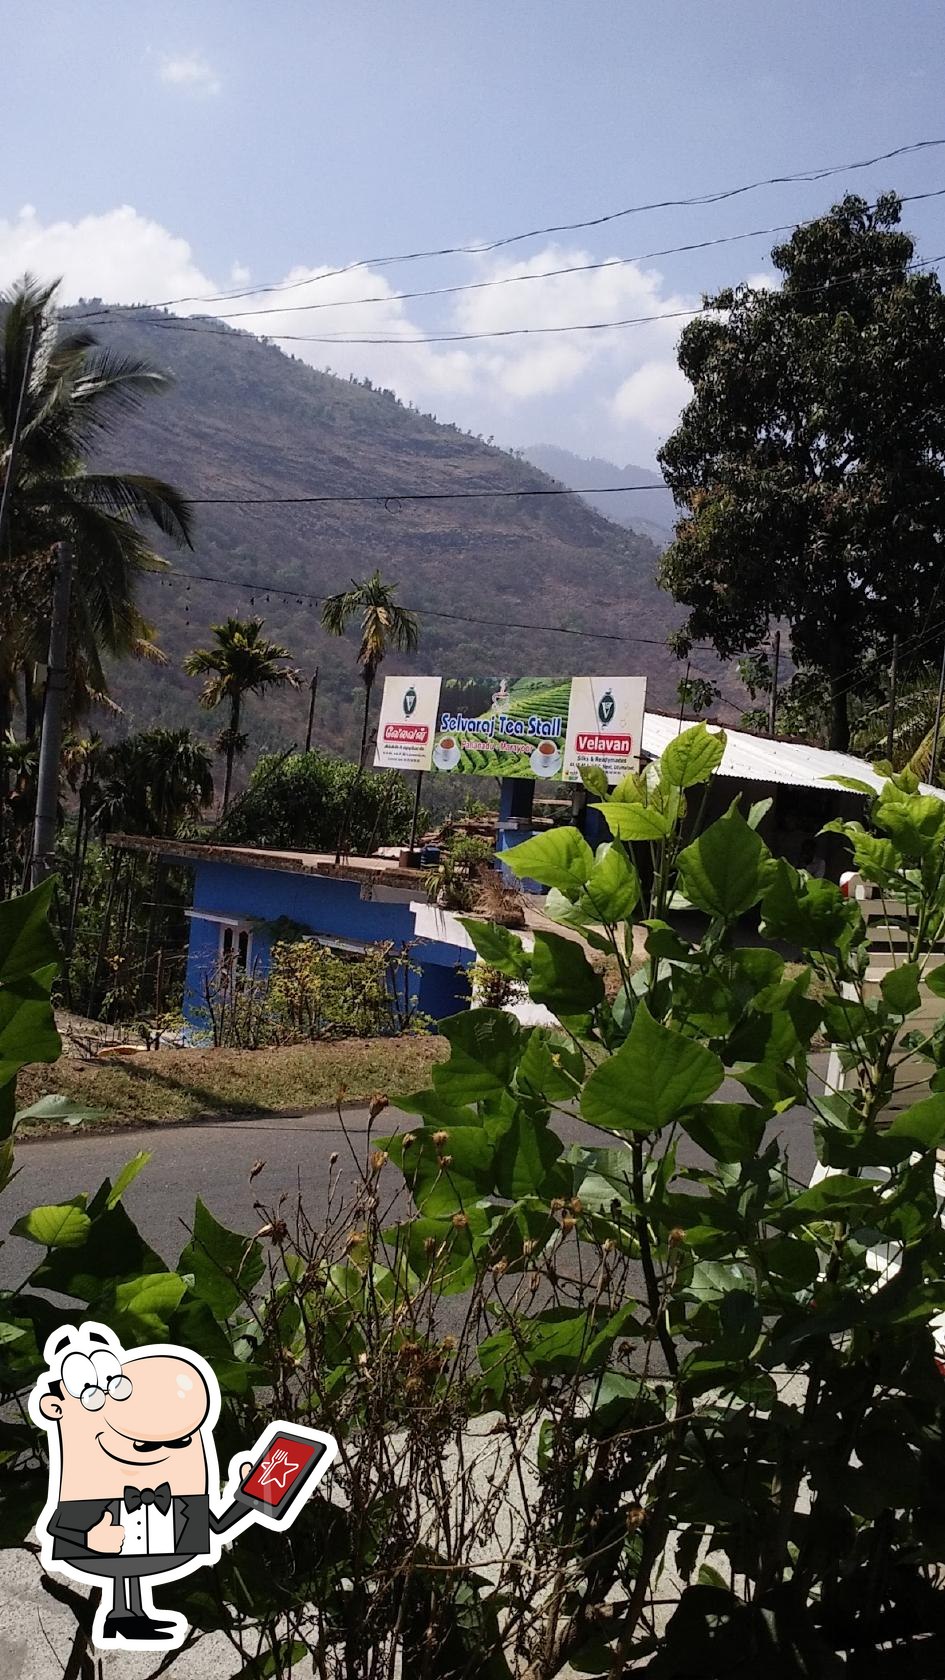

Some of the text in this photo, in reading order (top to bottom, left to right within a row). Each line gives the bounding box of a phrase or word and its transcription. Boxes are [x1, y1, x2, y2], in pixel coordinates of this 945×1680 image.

[440, 713, 561, 737] Selvaraj Tea Stall
[500, 741, 533, 754] Marayoor
[578, 735, 630, 752] Velavan
[595, 756, 627, 764] Readymades
